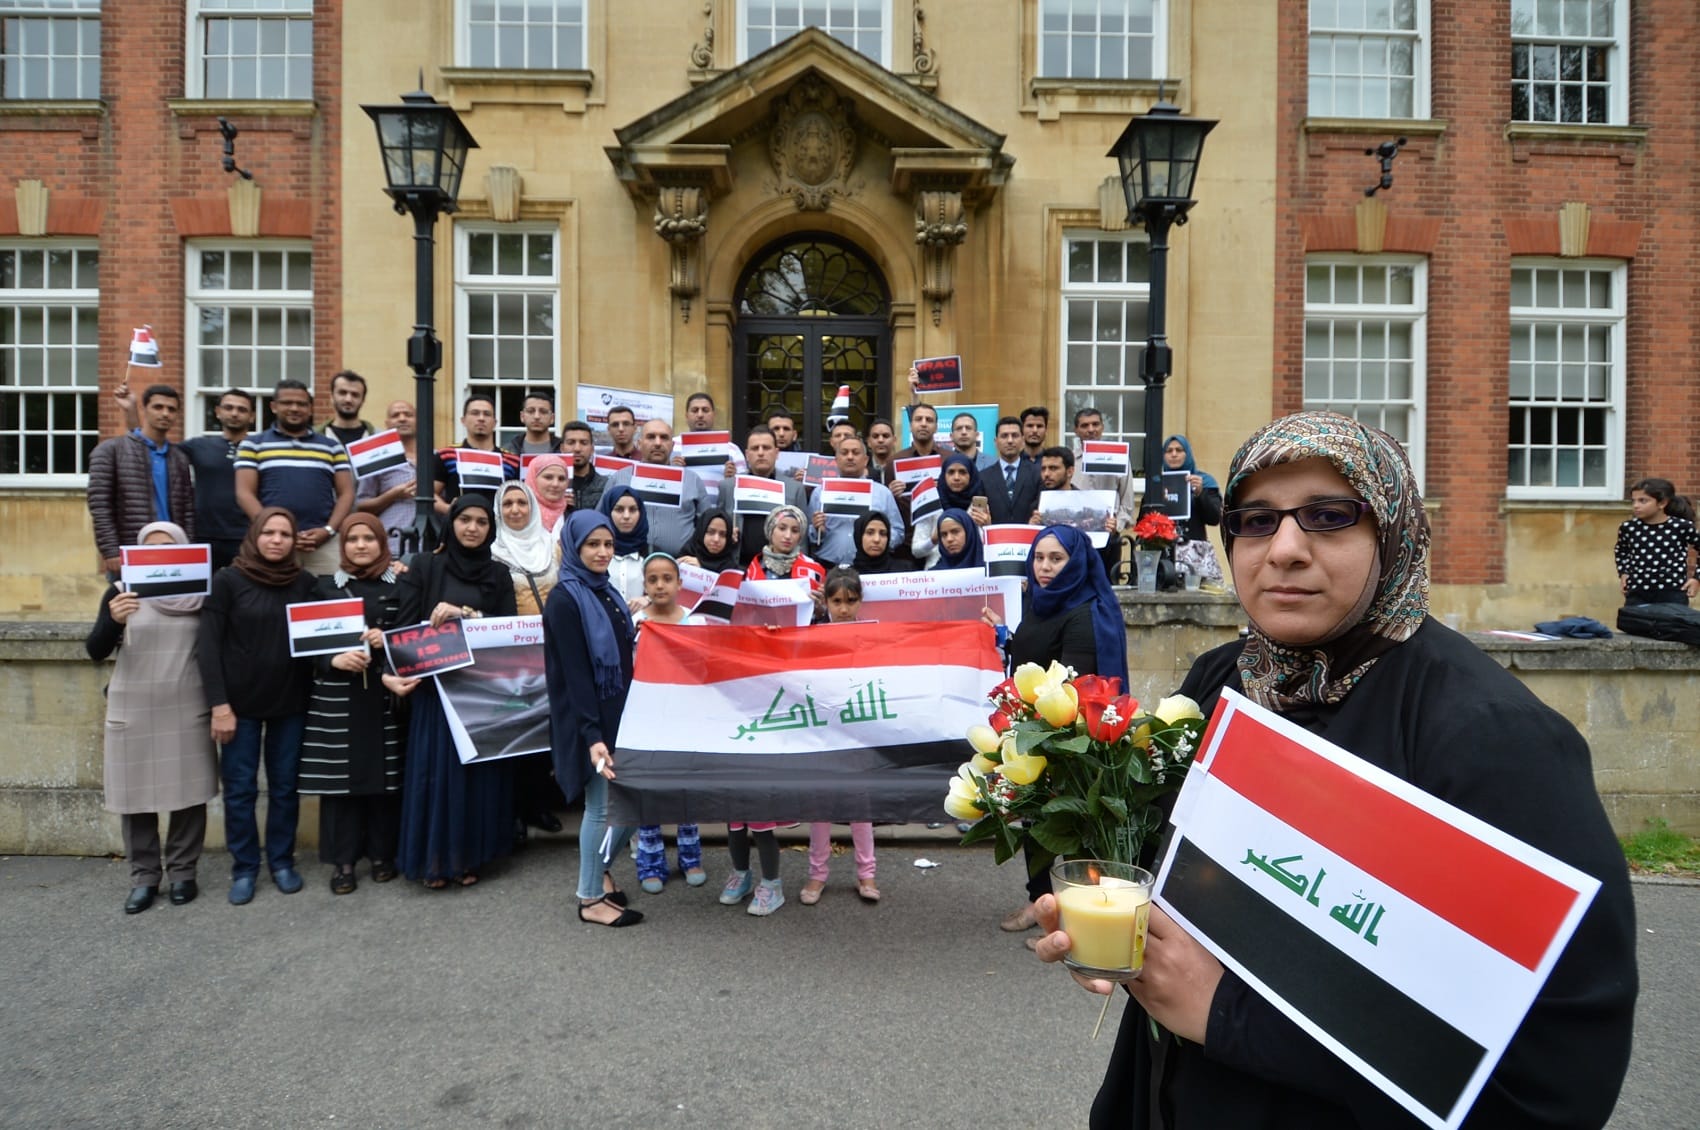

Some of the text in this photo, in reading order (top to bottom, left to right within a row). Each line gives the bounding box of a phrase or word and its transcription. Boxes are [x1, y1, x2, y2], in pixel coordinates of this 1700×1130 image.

[916, 359, 957, 371] IRAQ
[811, 457, 837, 466] IRA
[880, 577, 898, 585] and
[901, 576, 935, 584] Thanks
[899, 584, 999, 598] Pray for Iraq victims
[760, 596, 793, 604] victims
[466, 620, 544, 633] ove and Than
[391, 622, 460, 646] IRAQ
[513, 634, 540, 645] Pray
[416, 643, 441, 658] IS
